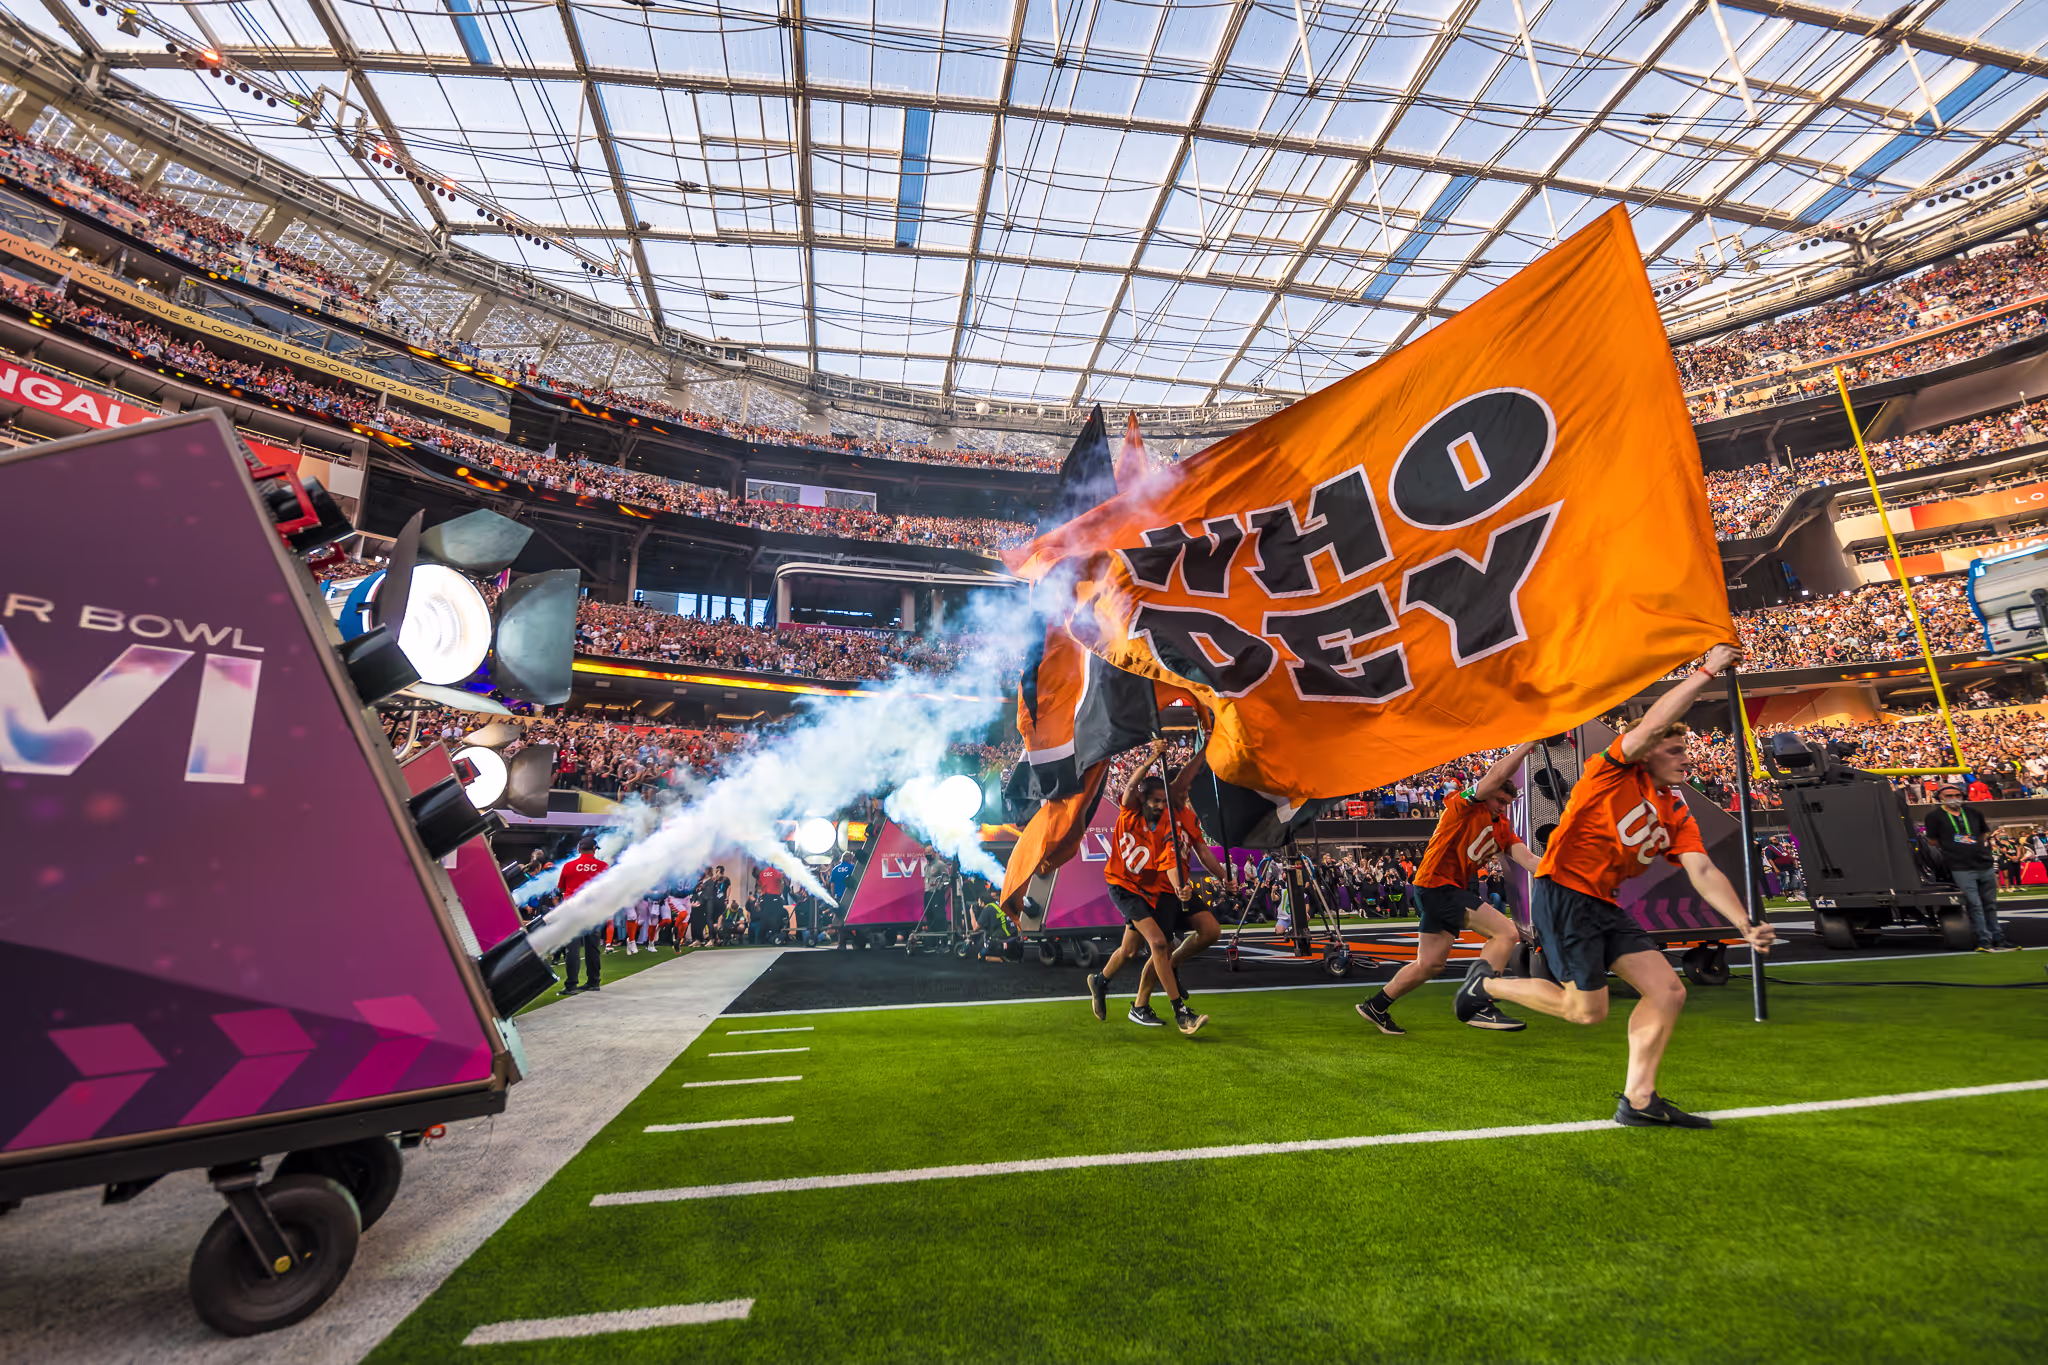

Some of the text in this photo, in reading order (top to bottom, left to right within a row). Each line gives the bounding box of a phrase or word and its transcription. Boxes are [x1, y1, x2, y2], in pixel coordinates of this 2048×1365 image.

[24, 246, 72, 271] WITH
[78, 269, 127, 297] YOUR
[130, 292, 181, 320] ISSUE
[184, 315, 196, 326] &
[200, 320, 278, 352] LOCATION
[281, 348, 301, 360] TO
[0, 368, 163, 429] NGAL
[1114, 387, 1557, 598] WHO
[78, 604, 265, 653] BOWL
[1128, 500, 1565, 703] DEY
[804, 626, 843, 637] SUPER
[845, 629, 879, 640] BOWL
[576, 864, 597, 872] CSC
